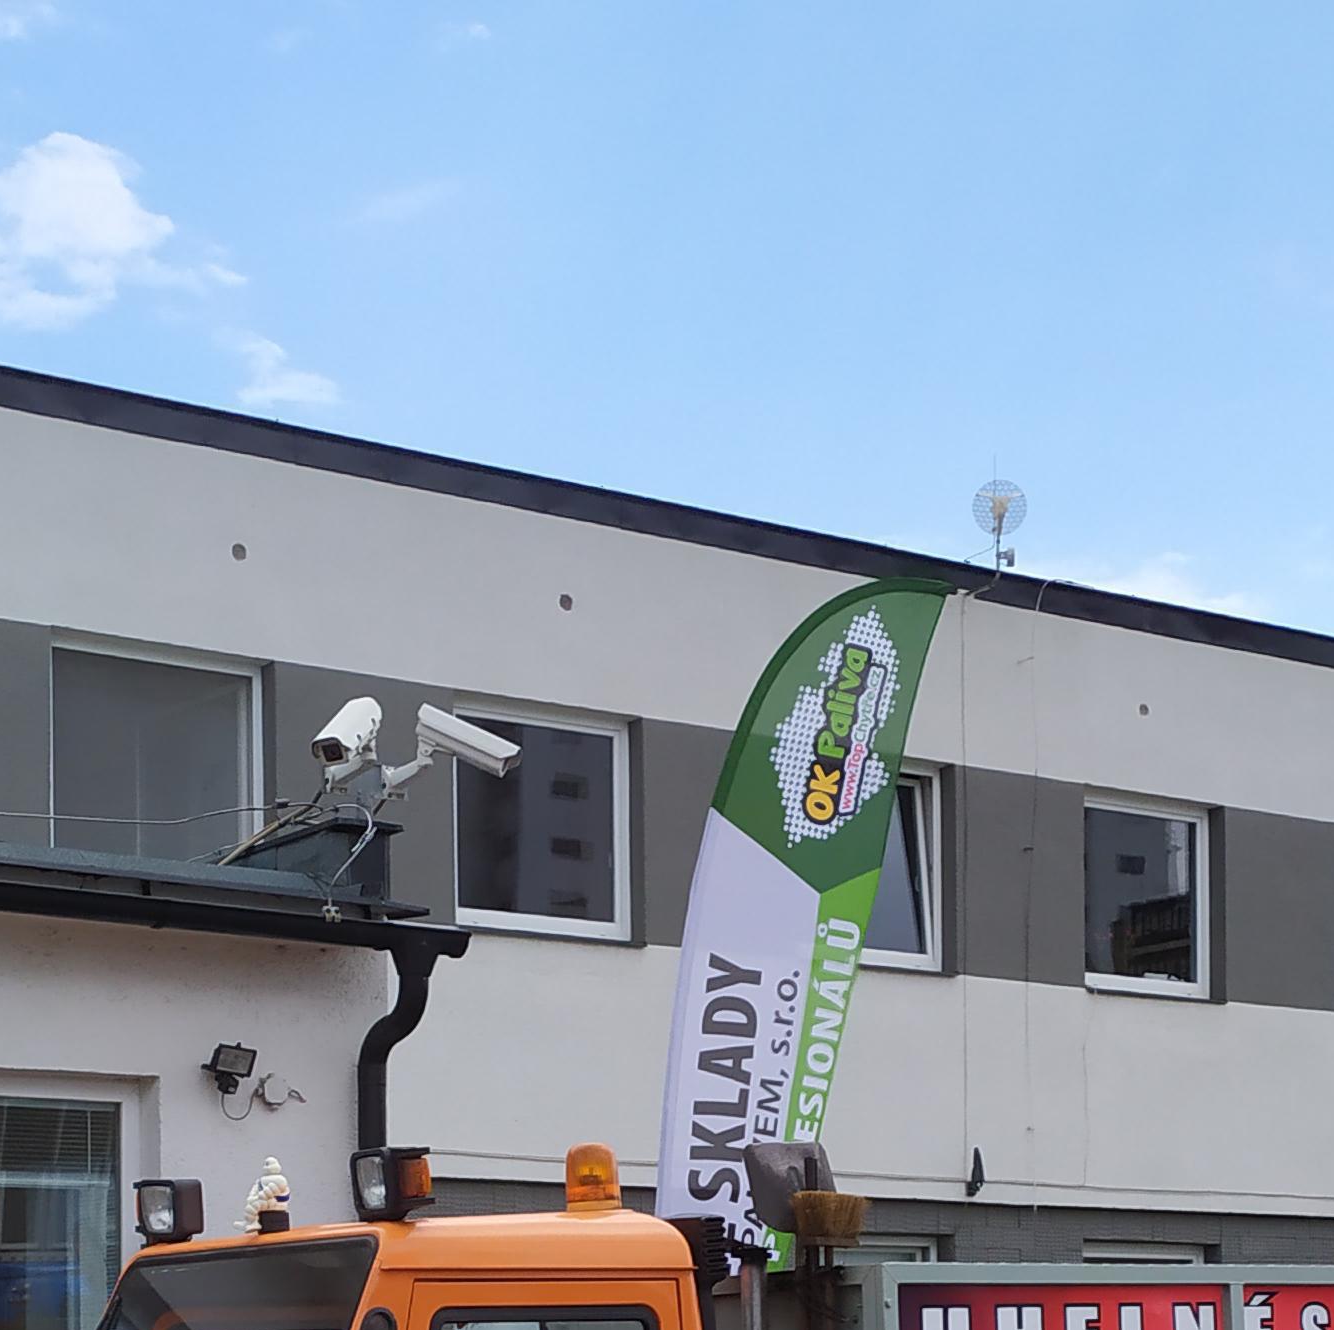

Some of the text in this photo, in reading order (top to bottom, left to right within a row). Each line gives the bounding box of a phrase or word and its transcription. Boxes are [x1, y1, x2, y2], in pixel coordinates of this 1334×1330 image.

[806, 648, 868, 821] OK Paliva
[688, 953, 763, 1204] SKLADY
[771, 969, 801, 1056] s.r.o.
